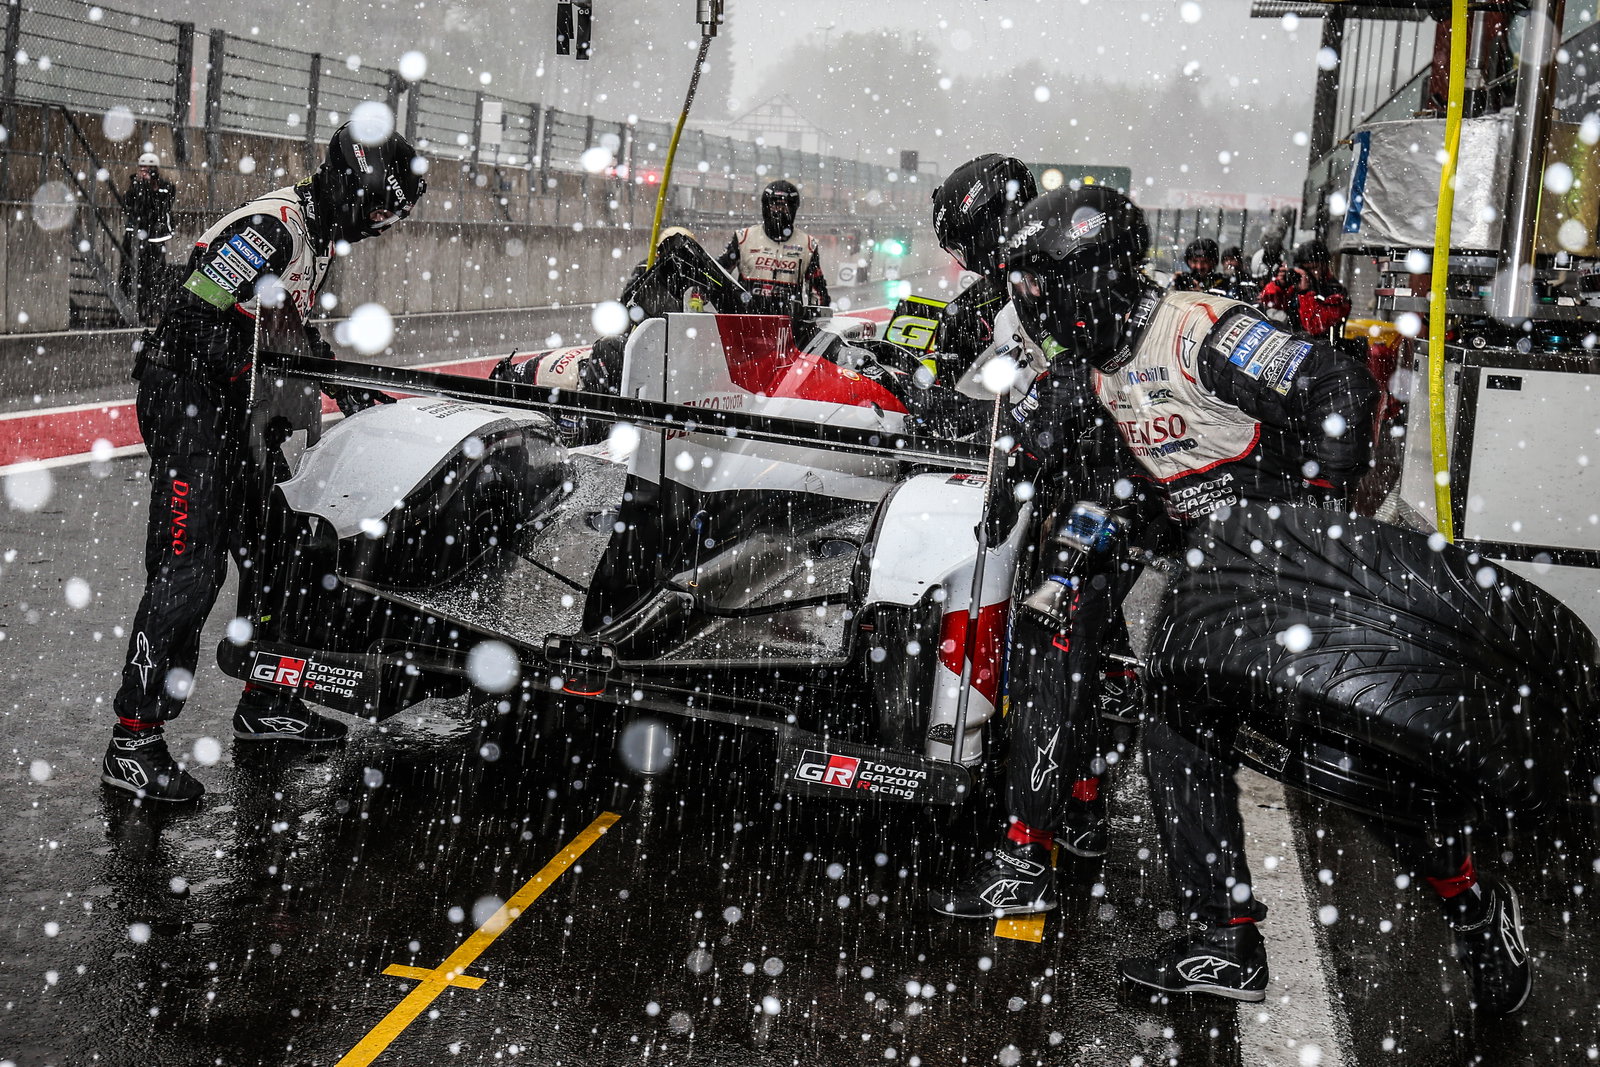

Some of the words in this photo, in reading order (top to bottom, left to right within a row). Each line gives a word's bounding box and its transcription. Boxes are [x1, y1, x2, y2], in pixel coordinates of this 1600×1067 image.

[387, 174, 406, 203] uvex
[244, 231, 274, 255] JTEKT
[1014, 220, 1046, 249] uvex
[1072, 225, 1090, 240] GR
[233, 240, 262, 265] AISIN
[755, 256, 797, 269] DENSO
[215, 261, 240, 284] ADVICS
[1137, 299, 1156, 328] TMG
[1220, 319, 1253, 353] JTEKT
[1237, 325, 1270, 363] AISIN
[1288, 347, 1308, 380] MICHELIN
[722, 394, 743, 410] TOYOTA
[1151, 438, 1199, 459] HYBRID
[1170, 473, 1234, 501] TOYOTA
[1175, 486, 1233, 513] GAZOO
[1184, 495, 1238, 519] acing
[171, 479, 189, 555] DENSO
[253, 664, 300, 685] GR
[305, 671, 356, 687] GAZOO
[309, 661, 363, 679] TOYOTA
[303, 680, 354, 698] Racing
[799, 763, 853, 786] GR
[859, 771, 919, 788] GAZOO
[864, 760, 927, 780] TOYOTA
[857, 780, 915, 800] Racing
